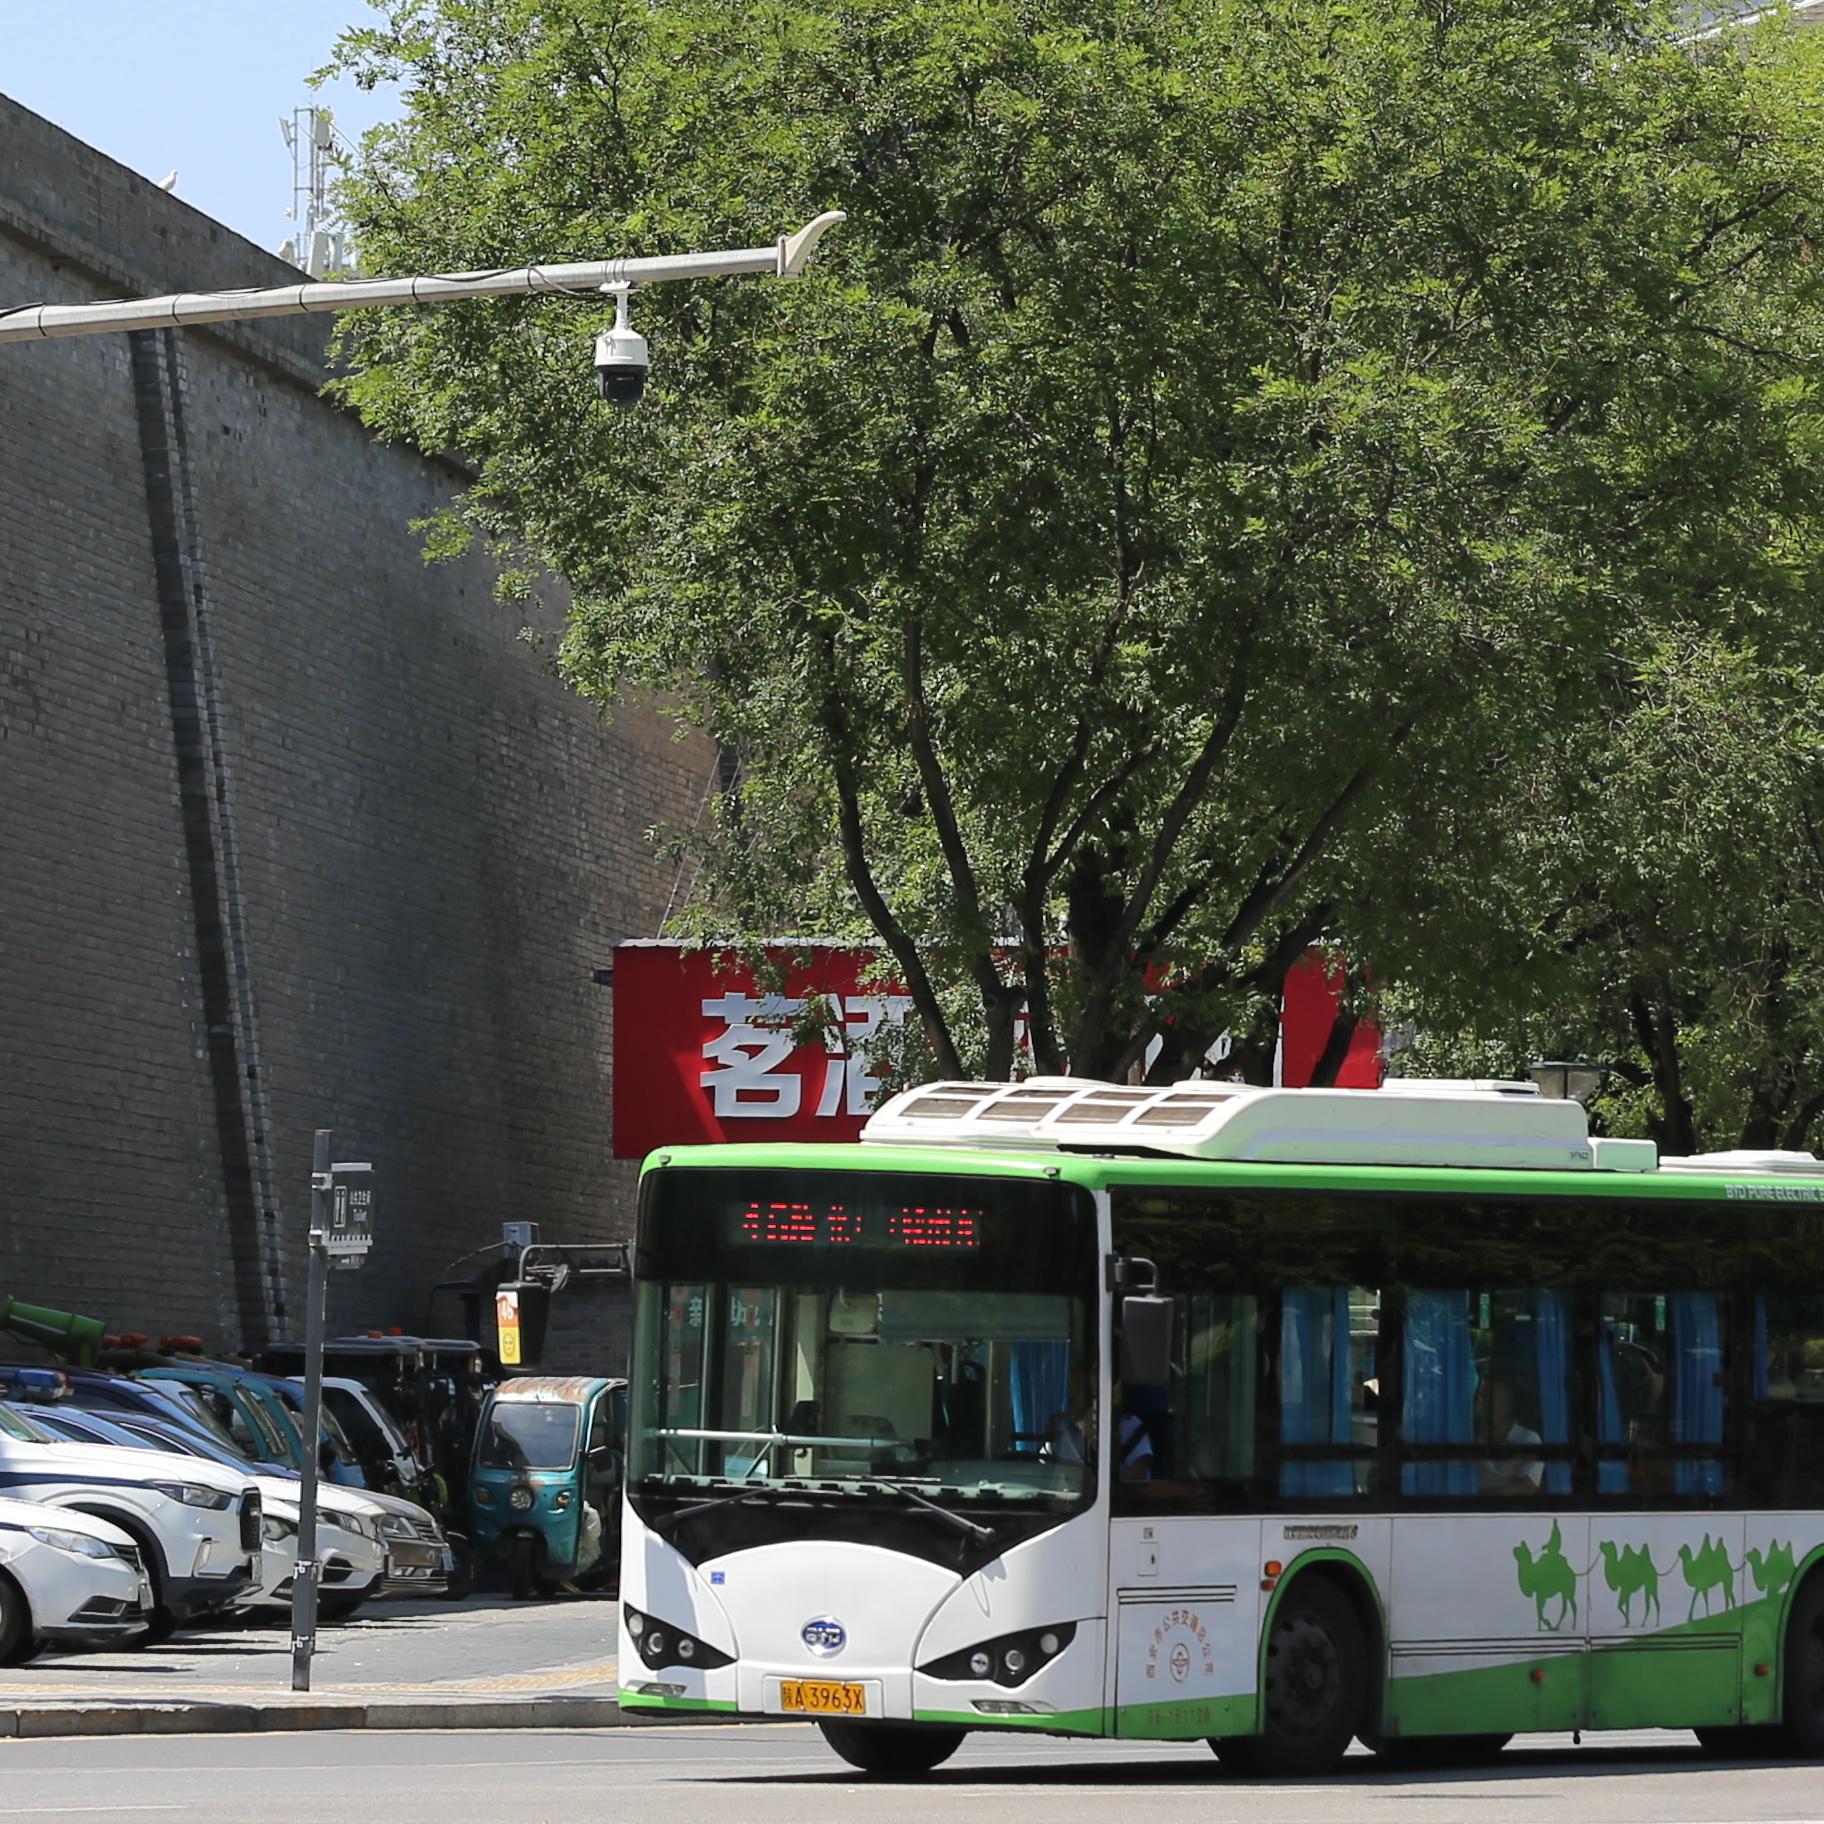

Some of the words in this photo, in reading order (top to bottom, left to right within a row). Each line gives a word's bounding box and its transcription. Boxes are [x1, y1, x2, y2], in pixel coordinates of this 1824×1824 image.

[1724, 1184, 1746, 1199] BYD
[1747, 1185, 1775, 1200] PURE
[1776, 1186, 1818, 1202] ELECTRIC
